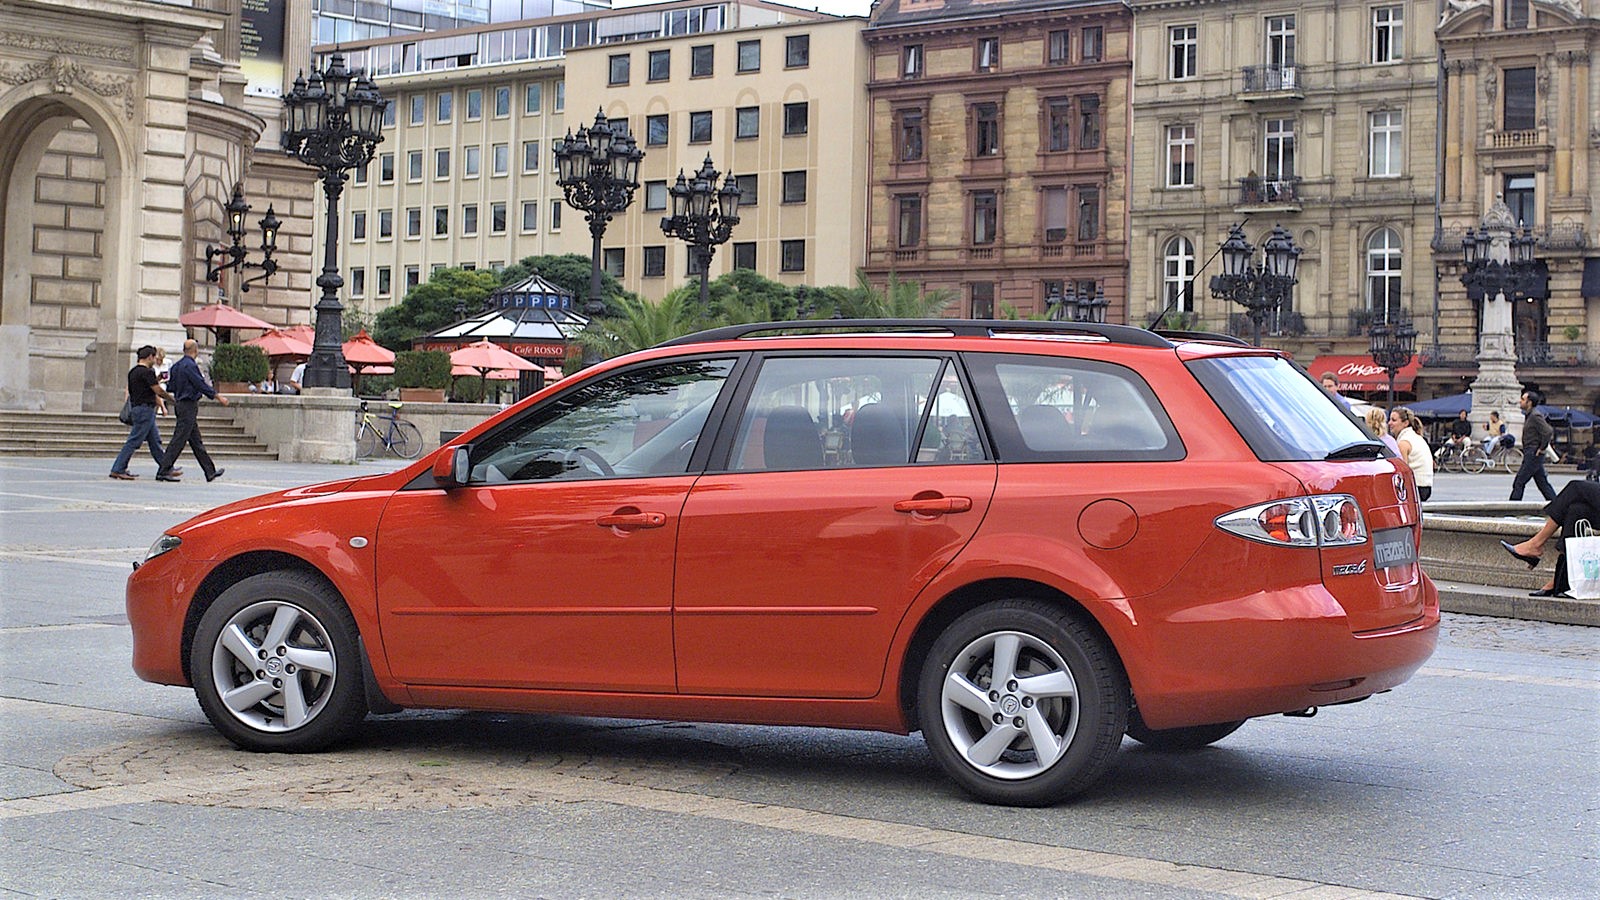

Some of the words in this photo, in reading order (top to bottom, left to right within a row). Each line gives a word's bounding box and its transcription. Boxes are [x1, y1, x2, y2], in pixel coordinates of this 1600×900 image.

[502, 297, 508, 307] P
[515, 297, 523, 307] P
[532, 297, 540, 307] P
[548, 298, 556, 308] P
[561, 299, 568, 309] P
